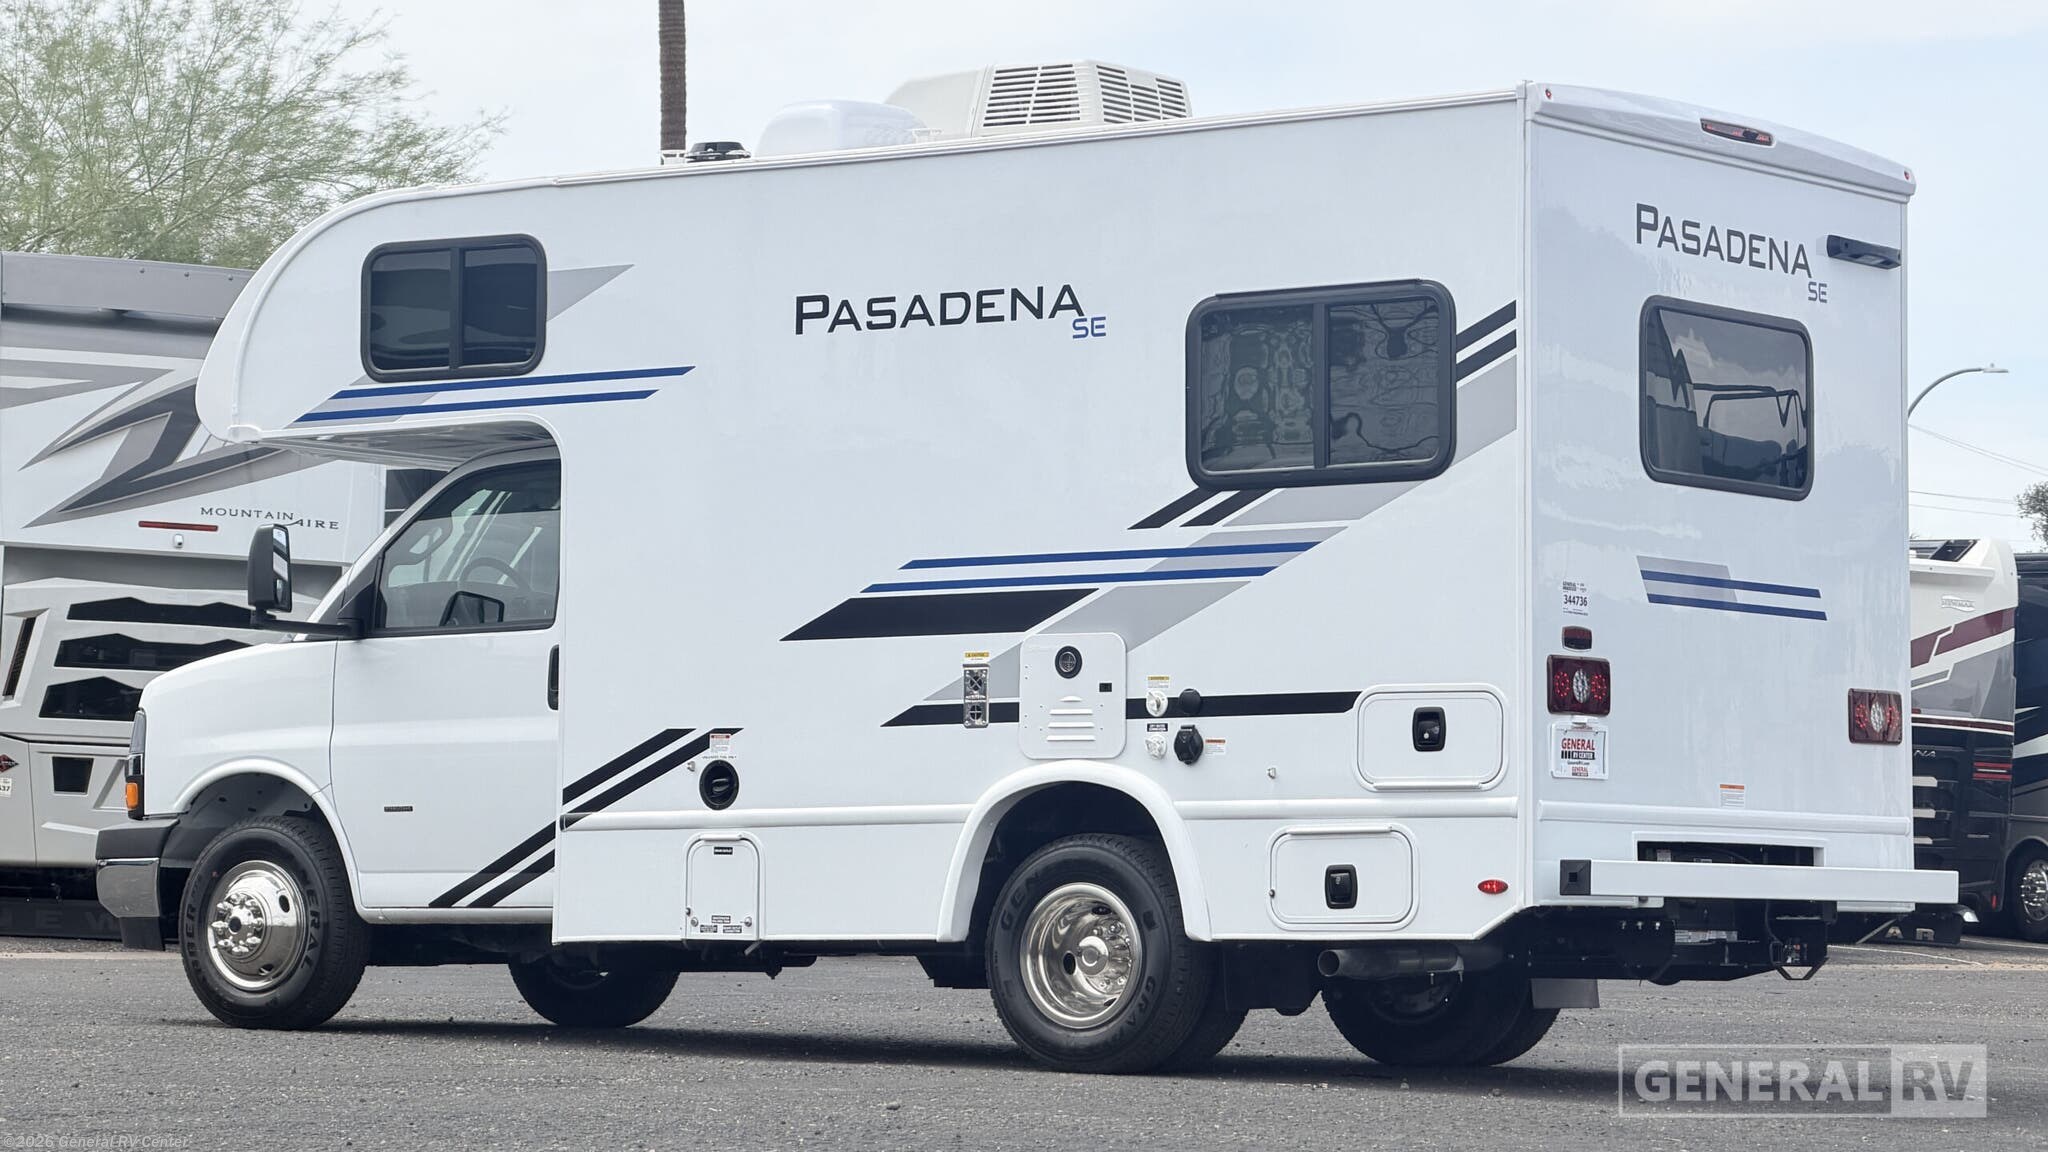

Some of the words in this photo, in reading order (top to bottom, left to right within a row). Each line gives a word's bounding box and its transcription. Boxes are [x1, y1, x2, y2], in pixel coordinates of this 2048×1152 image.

[1636, 203, 1812, 278] PASADENA
[1808, 281, 1828, 303] SE
[796, 284, 1085, 335] PASADENA
[1072, 316, 1107, 339] SE
[200, 506, 295, 521] MOUNTAIN
[1563, 594, 1588, 607] 344736
[1561, 737, 1596, 751] GENERAL
